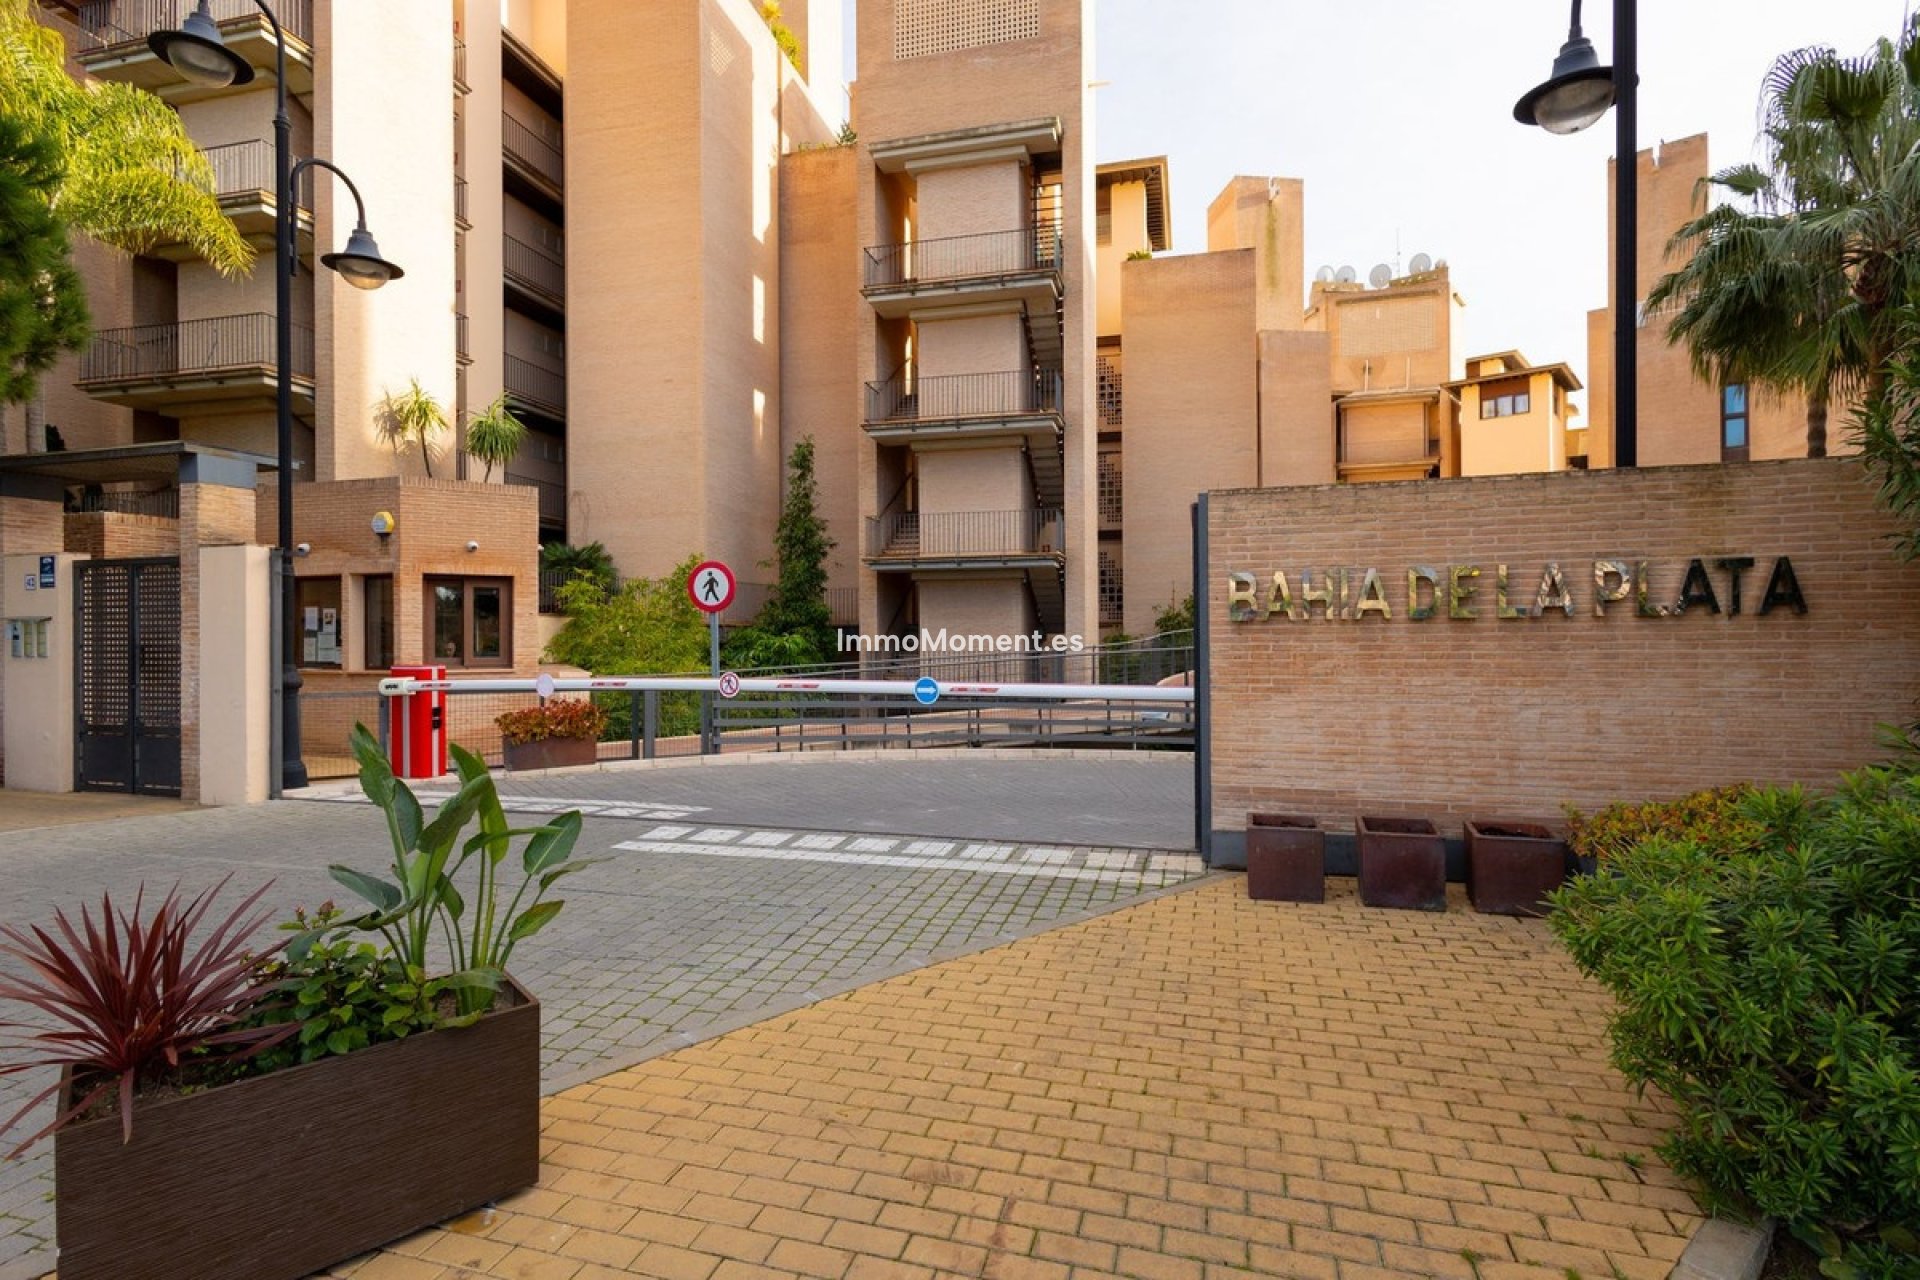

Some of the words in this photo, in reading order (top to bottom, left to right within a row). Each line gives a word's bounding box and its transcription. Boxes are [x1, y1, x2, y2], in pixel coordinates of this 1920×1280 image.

[1229, 567, 1393, 622] BAHIA
[1408, 565, 1481, 620] DE
[1497, 562, 1575, 619] LA
[1592, 556, 1809, 619] PLATA
